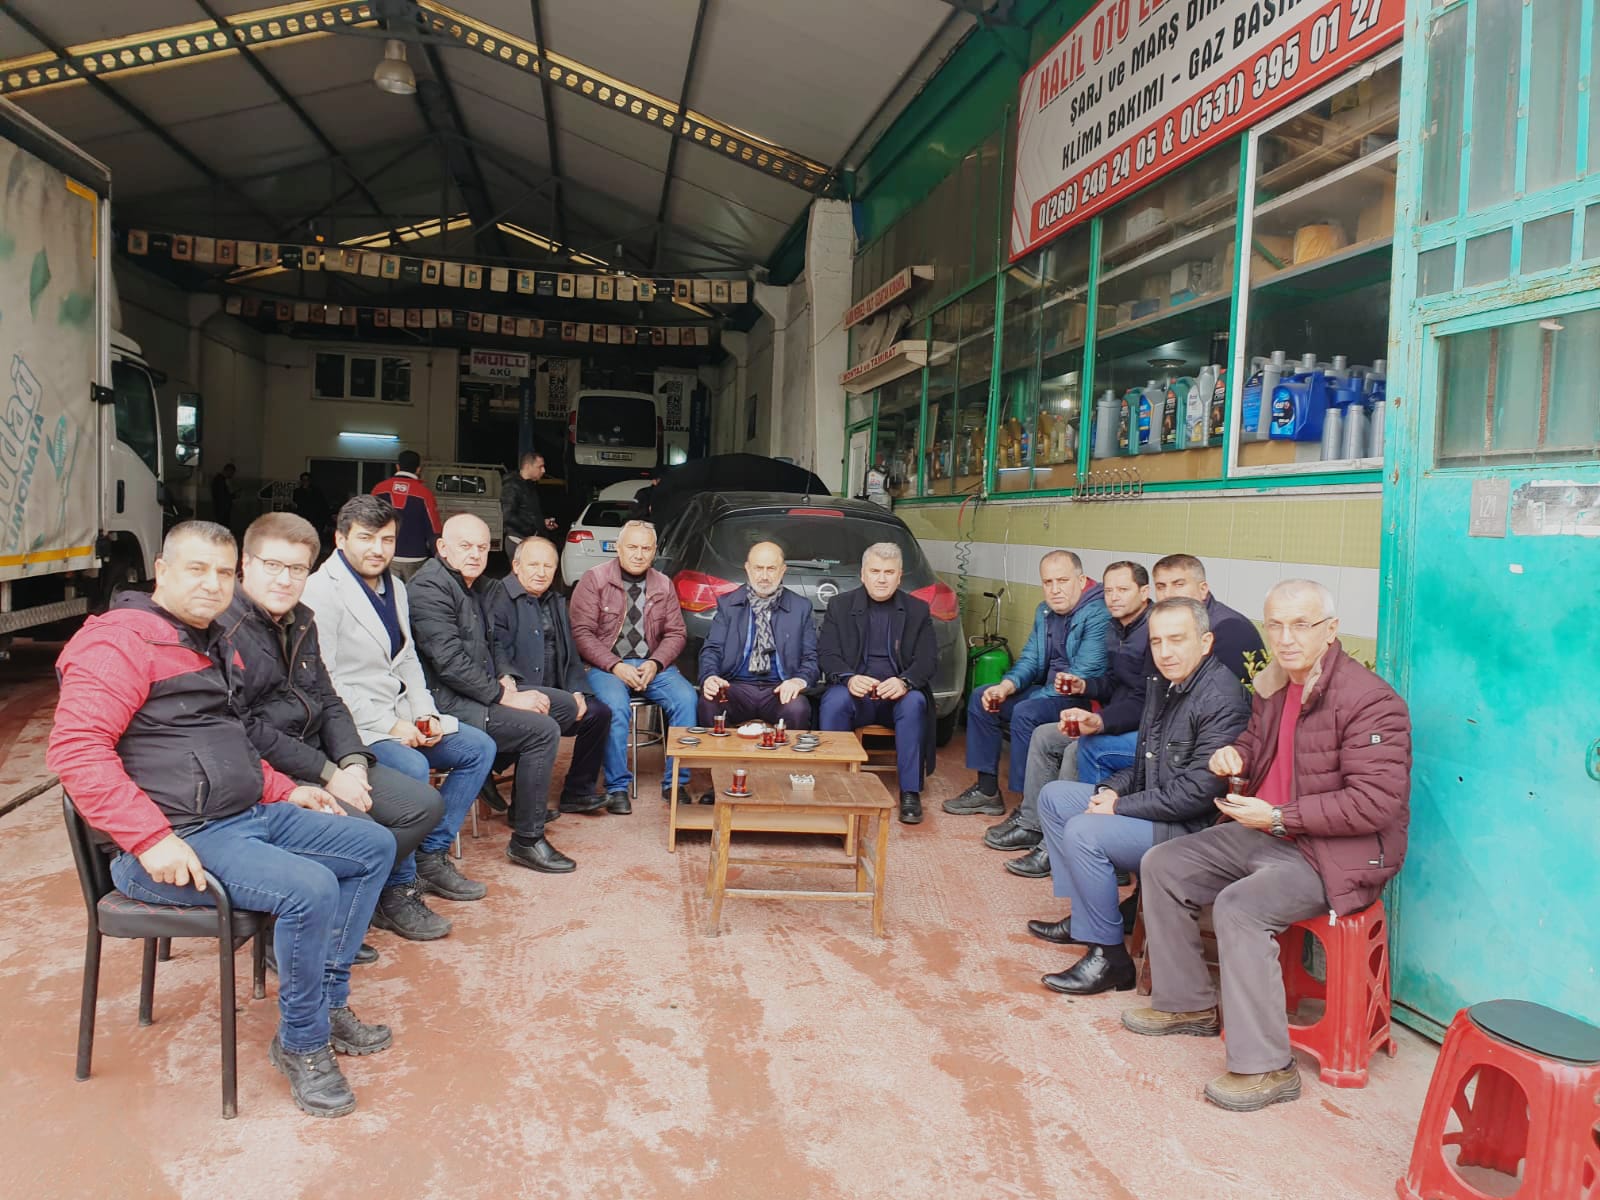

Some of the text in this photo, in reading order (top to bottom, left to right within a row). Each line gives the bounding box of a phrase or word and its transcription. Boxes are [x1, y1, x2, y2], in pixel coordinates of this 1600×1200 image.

[1039, 0, 1130, 111] HALİL OTO
[1062, 121, 1101, 170] KLİMA
[1108, 73, 1165, 138] BAKIMI
[1189, 27, 1225, 80] GAZ
[1070, 75, 1103, 126] ŞARJ
[1108, 60, 1125, 92] ve
[1131, 12, 1179, 75] MARŞ
[1038, 179, 1078, 231] 0(266)
[1081, 161, 1108, 206] 246
[1111, 145, 1131, 187] 24
[1135, 128, 1158, 172] 05
[1162, 117, 1175, 155] &
[1179, 69, 1245, 144] 0(531)
[1252, 32, 1300, 99] 395
[1309, 3, 1341, 64] 01
[473, 351, 527, 368] MUTLU
